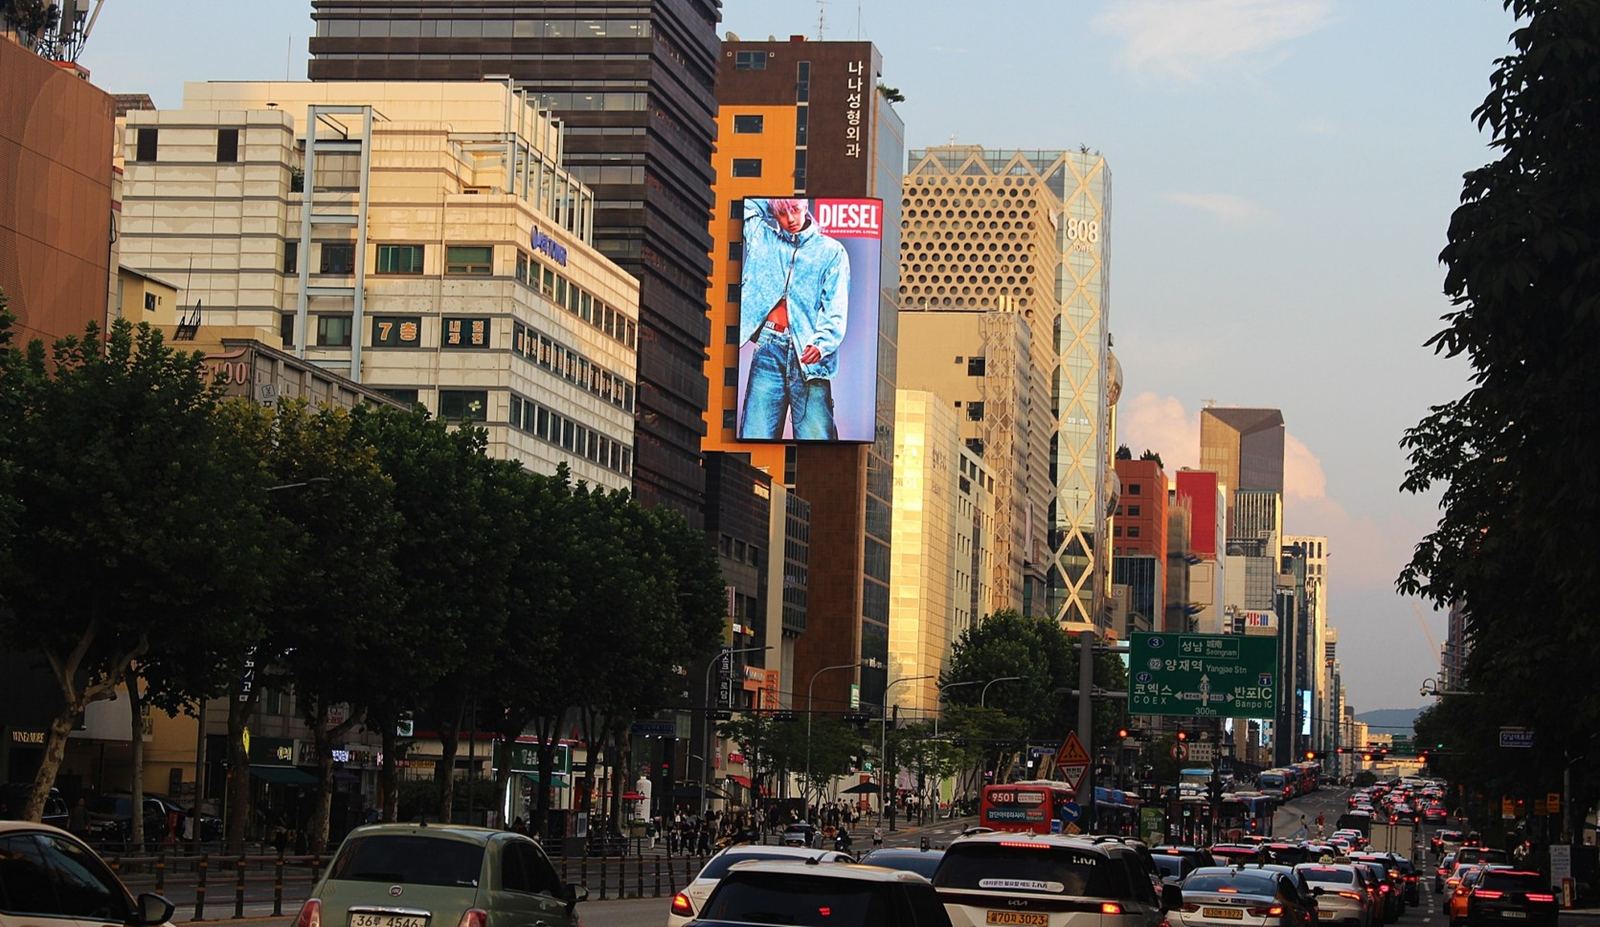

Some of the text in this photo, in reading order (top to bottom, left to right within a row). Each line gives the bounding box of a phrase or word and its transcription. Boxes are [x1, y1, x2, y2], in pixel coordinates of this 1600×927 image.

[845, 60, 864, 158] 나나성형외과
[819, 204, 879, 229] DIESEL
[1067, 218, 1098, 243] 808
[378, 321, 418, 342] 7층
[1153, 638, 1160, 647] 3
[1182, 641, 1203, 653] 성남
[1206, 648, 1237, 657] Seongnam
[1165, 659, 1203, 672] 양재역
[1235, 665, 1247, 674] Stn
[1138, 673, 1149, 681] 47
[1134, 684, 1173, 696] 코엑스
[1234, 686, 1272, 700] 반포IC
[1133, 697, 1167, 705] COEX
[1235, 700, 1272, 709] Banpo IC
[1195, 707, 1217, 716] 300m
[992, 793, 1014, 802] 9501
[386, 917, 418, 927] 4546
[1019, 914, 1045, 925] 3023
